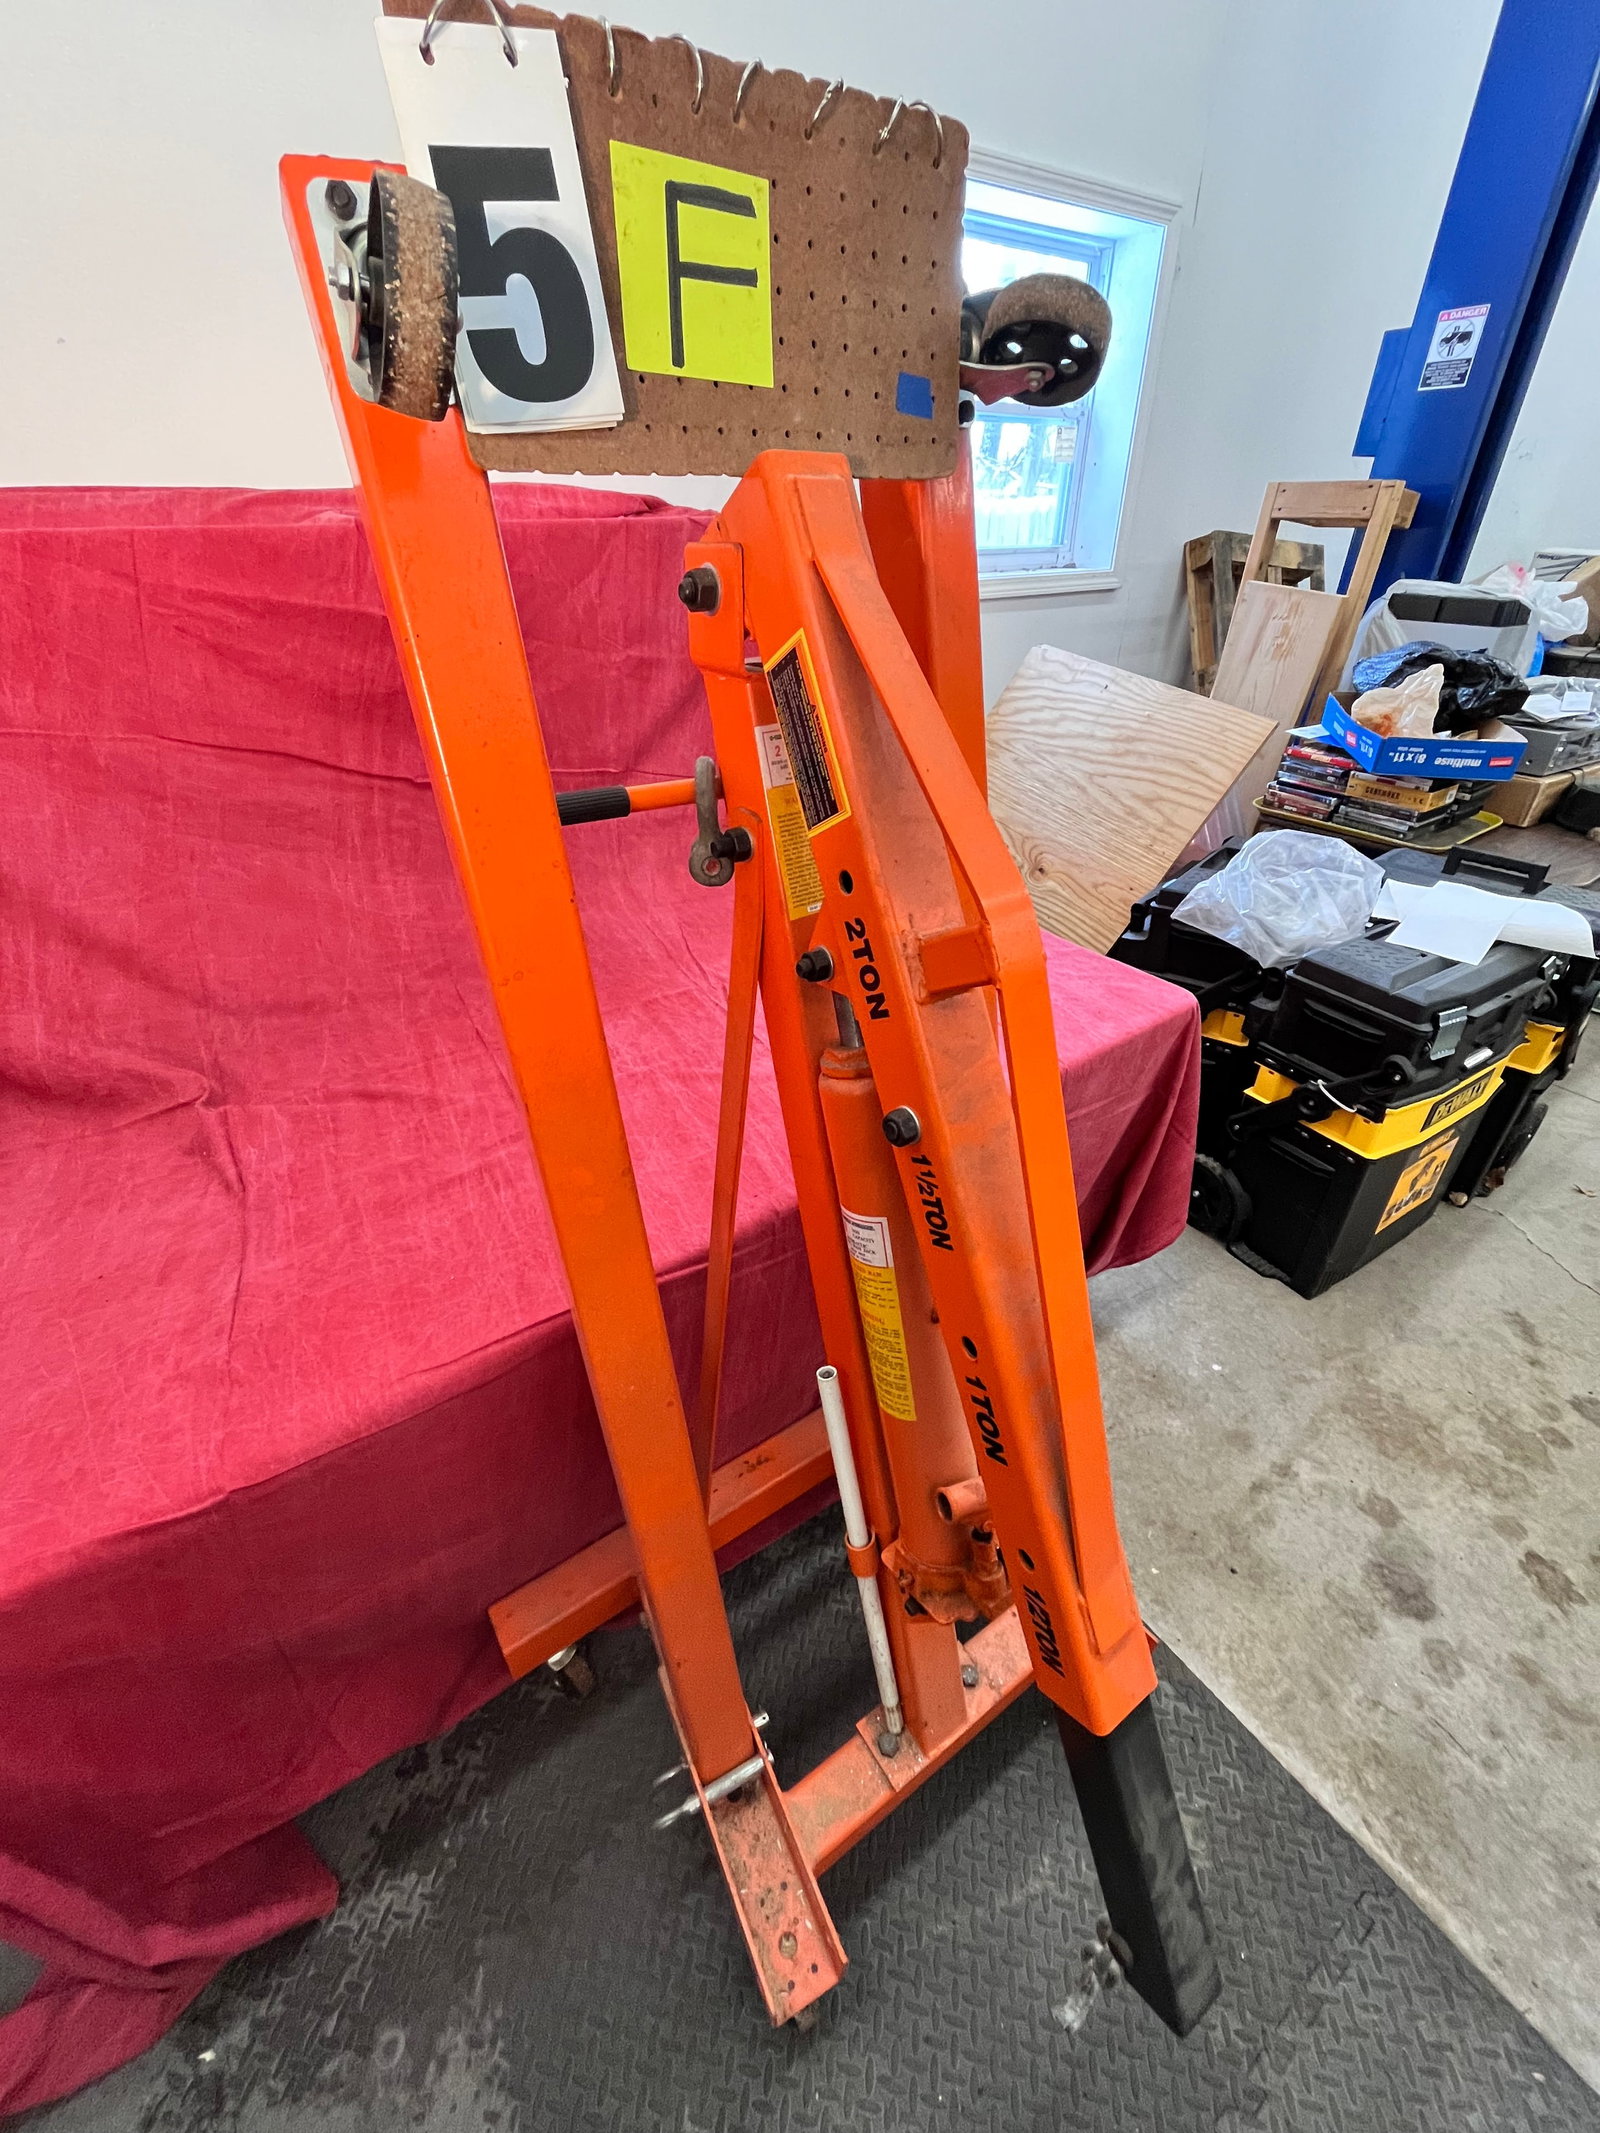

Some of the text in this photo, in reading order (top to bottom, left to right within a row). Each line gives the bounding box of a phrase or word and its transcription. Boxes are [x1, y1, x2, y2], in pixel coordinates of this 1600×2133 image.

[429, 145, 595, 403] 5
[665, 180, 758, 369] F
[1449, 307, 1487, 320] DANGER
[814, 712, 828, 754] WARNING
[1434, 757, 1483, 769] multiuse
